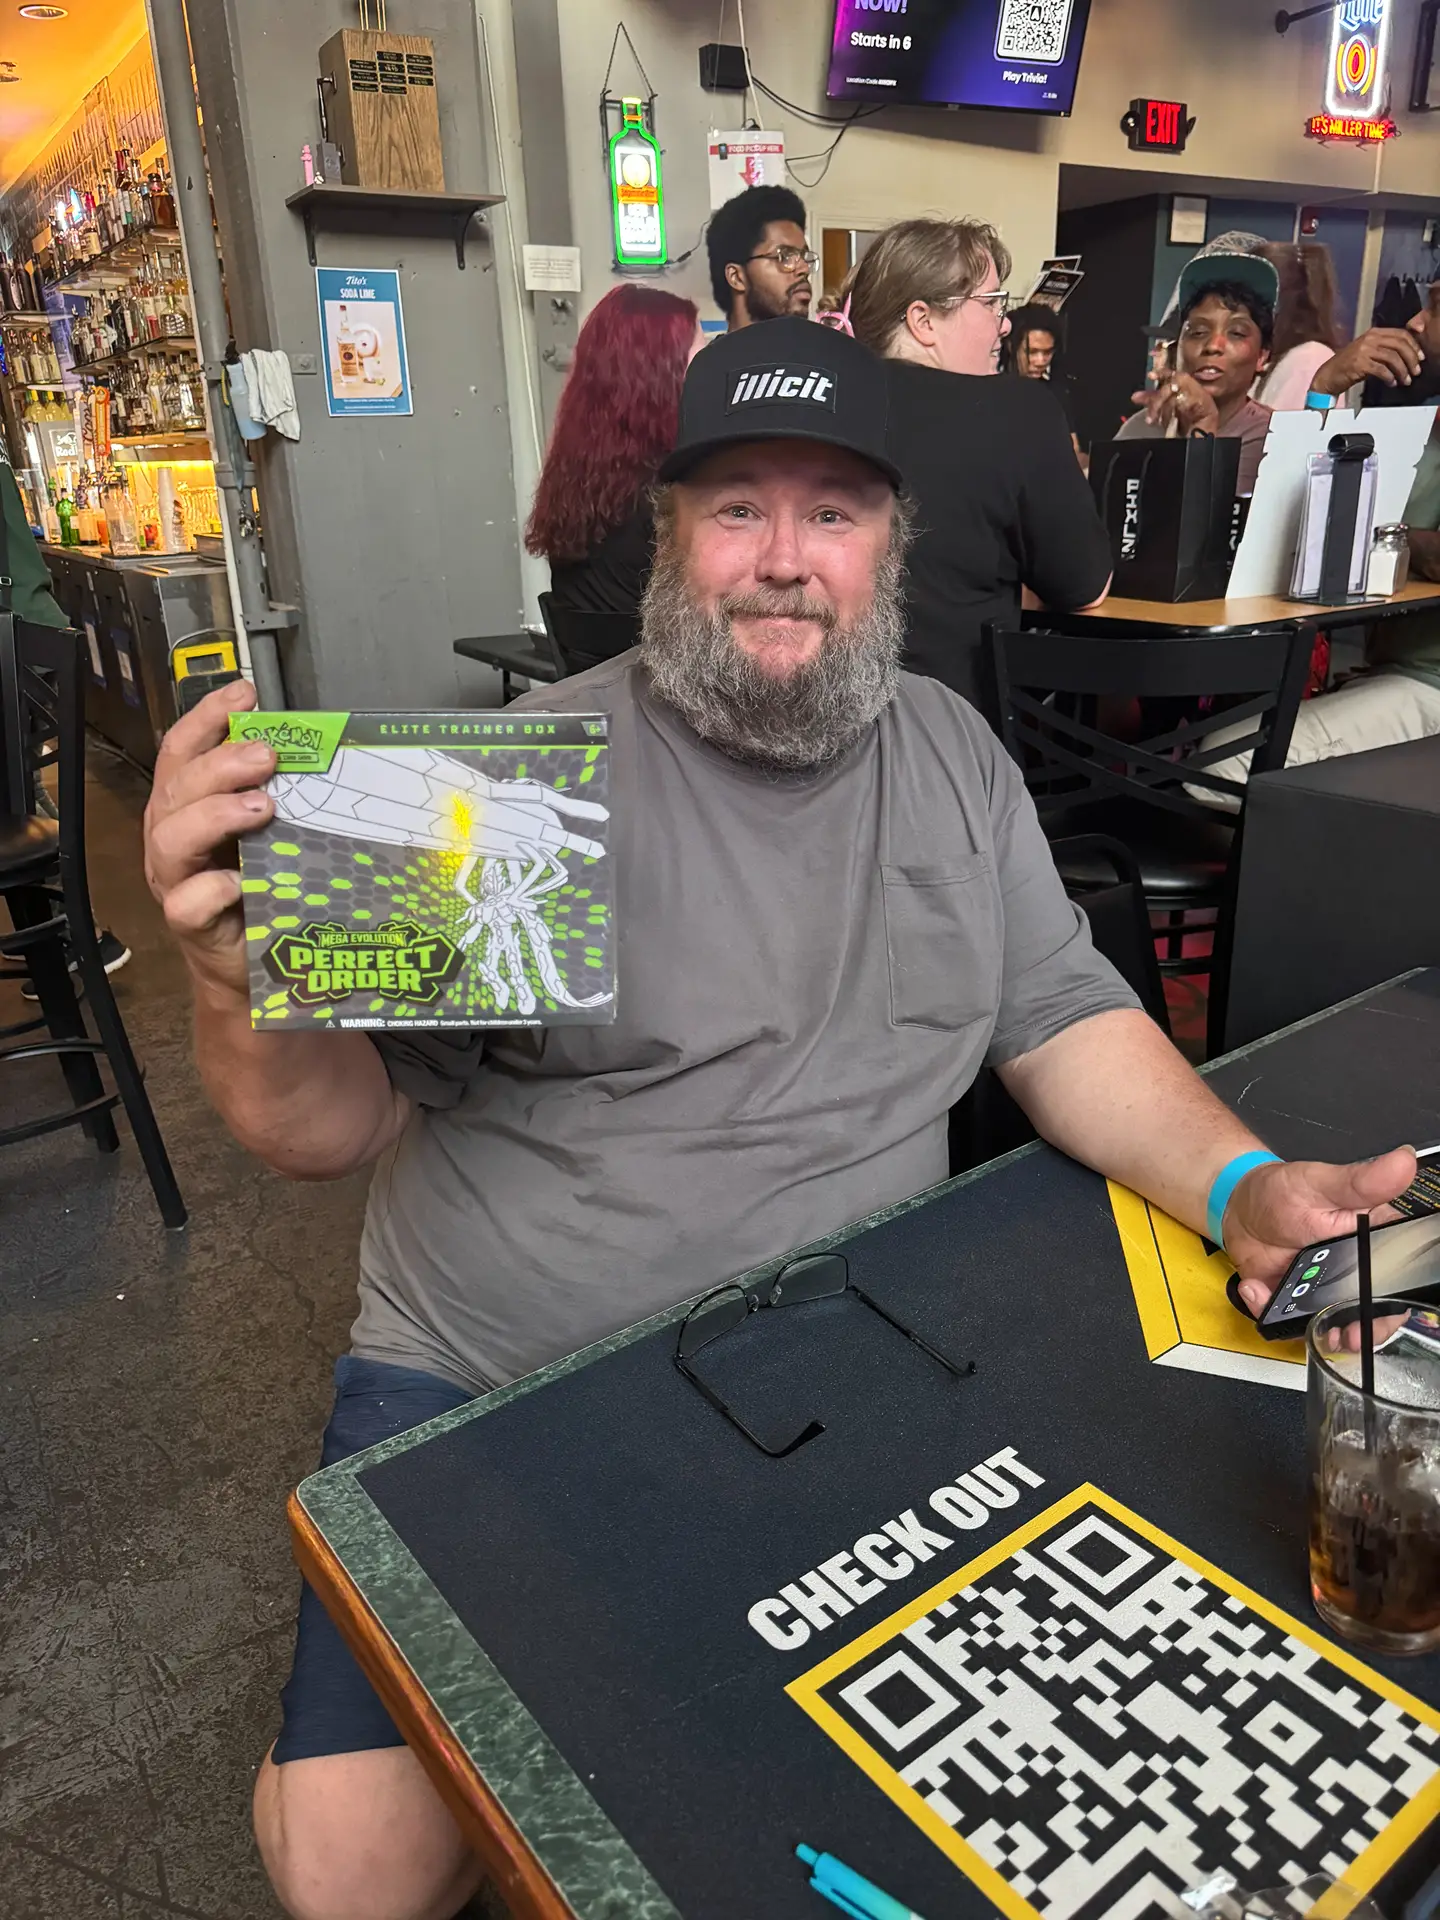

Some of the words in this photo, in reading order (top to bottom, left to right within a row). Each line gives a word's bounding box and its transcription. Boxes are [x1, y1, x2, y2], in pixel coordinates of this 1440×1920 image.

[851, 31, 887, 48] Starts
[889, 34, 901, 50] in
[902, 35, 912, 50] 6
[1003, 70, 1022, 84] Play
[1022, 72, 1048, 84] Trivia!
[1146, 101, 1181, 145] EXIT
[1311, 116, 1328, 135] IT'S
[1329, 118, 1362, 137] MILLER
[1364, 121, 1385, 139] TIME
[346, 275, 367, 285] Tito's
[340, 288, 359, 299] SODA
[731, 368, 833, 405] illicit
[379, 724, 431, 735] ELITE
[438, 724, 515, 735] TRAINER
[524, 724, 556, 735] BOX
[588, 724, 602, 735] 6+
[320, 933, 348, 947] MEGA
[351, 932, 405, 946] EVOLUTION
[289, 944, 437, 970] PERFECT
[307, 969, 422, 993] ORDER
[340, 1018, 386, 1028] WARNING:
[748, 1508, 955, 1651] CHECK
[929, 1446, 1046, 1530] OUT
